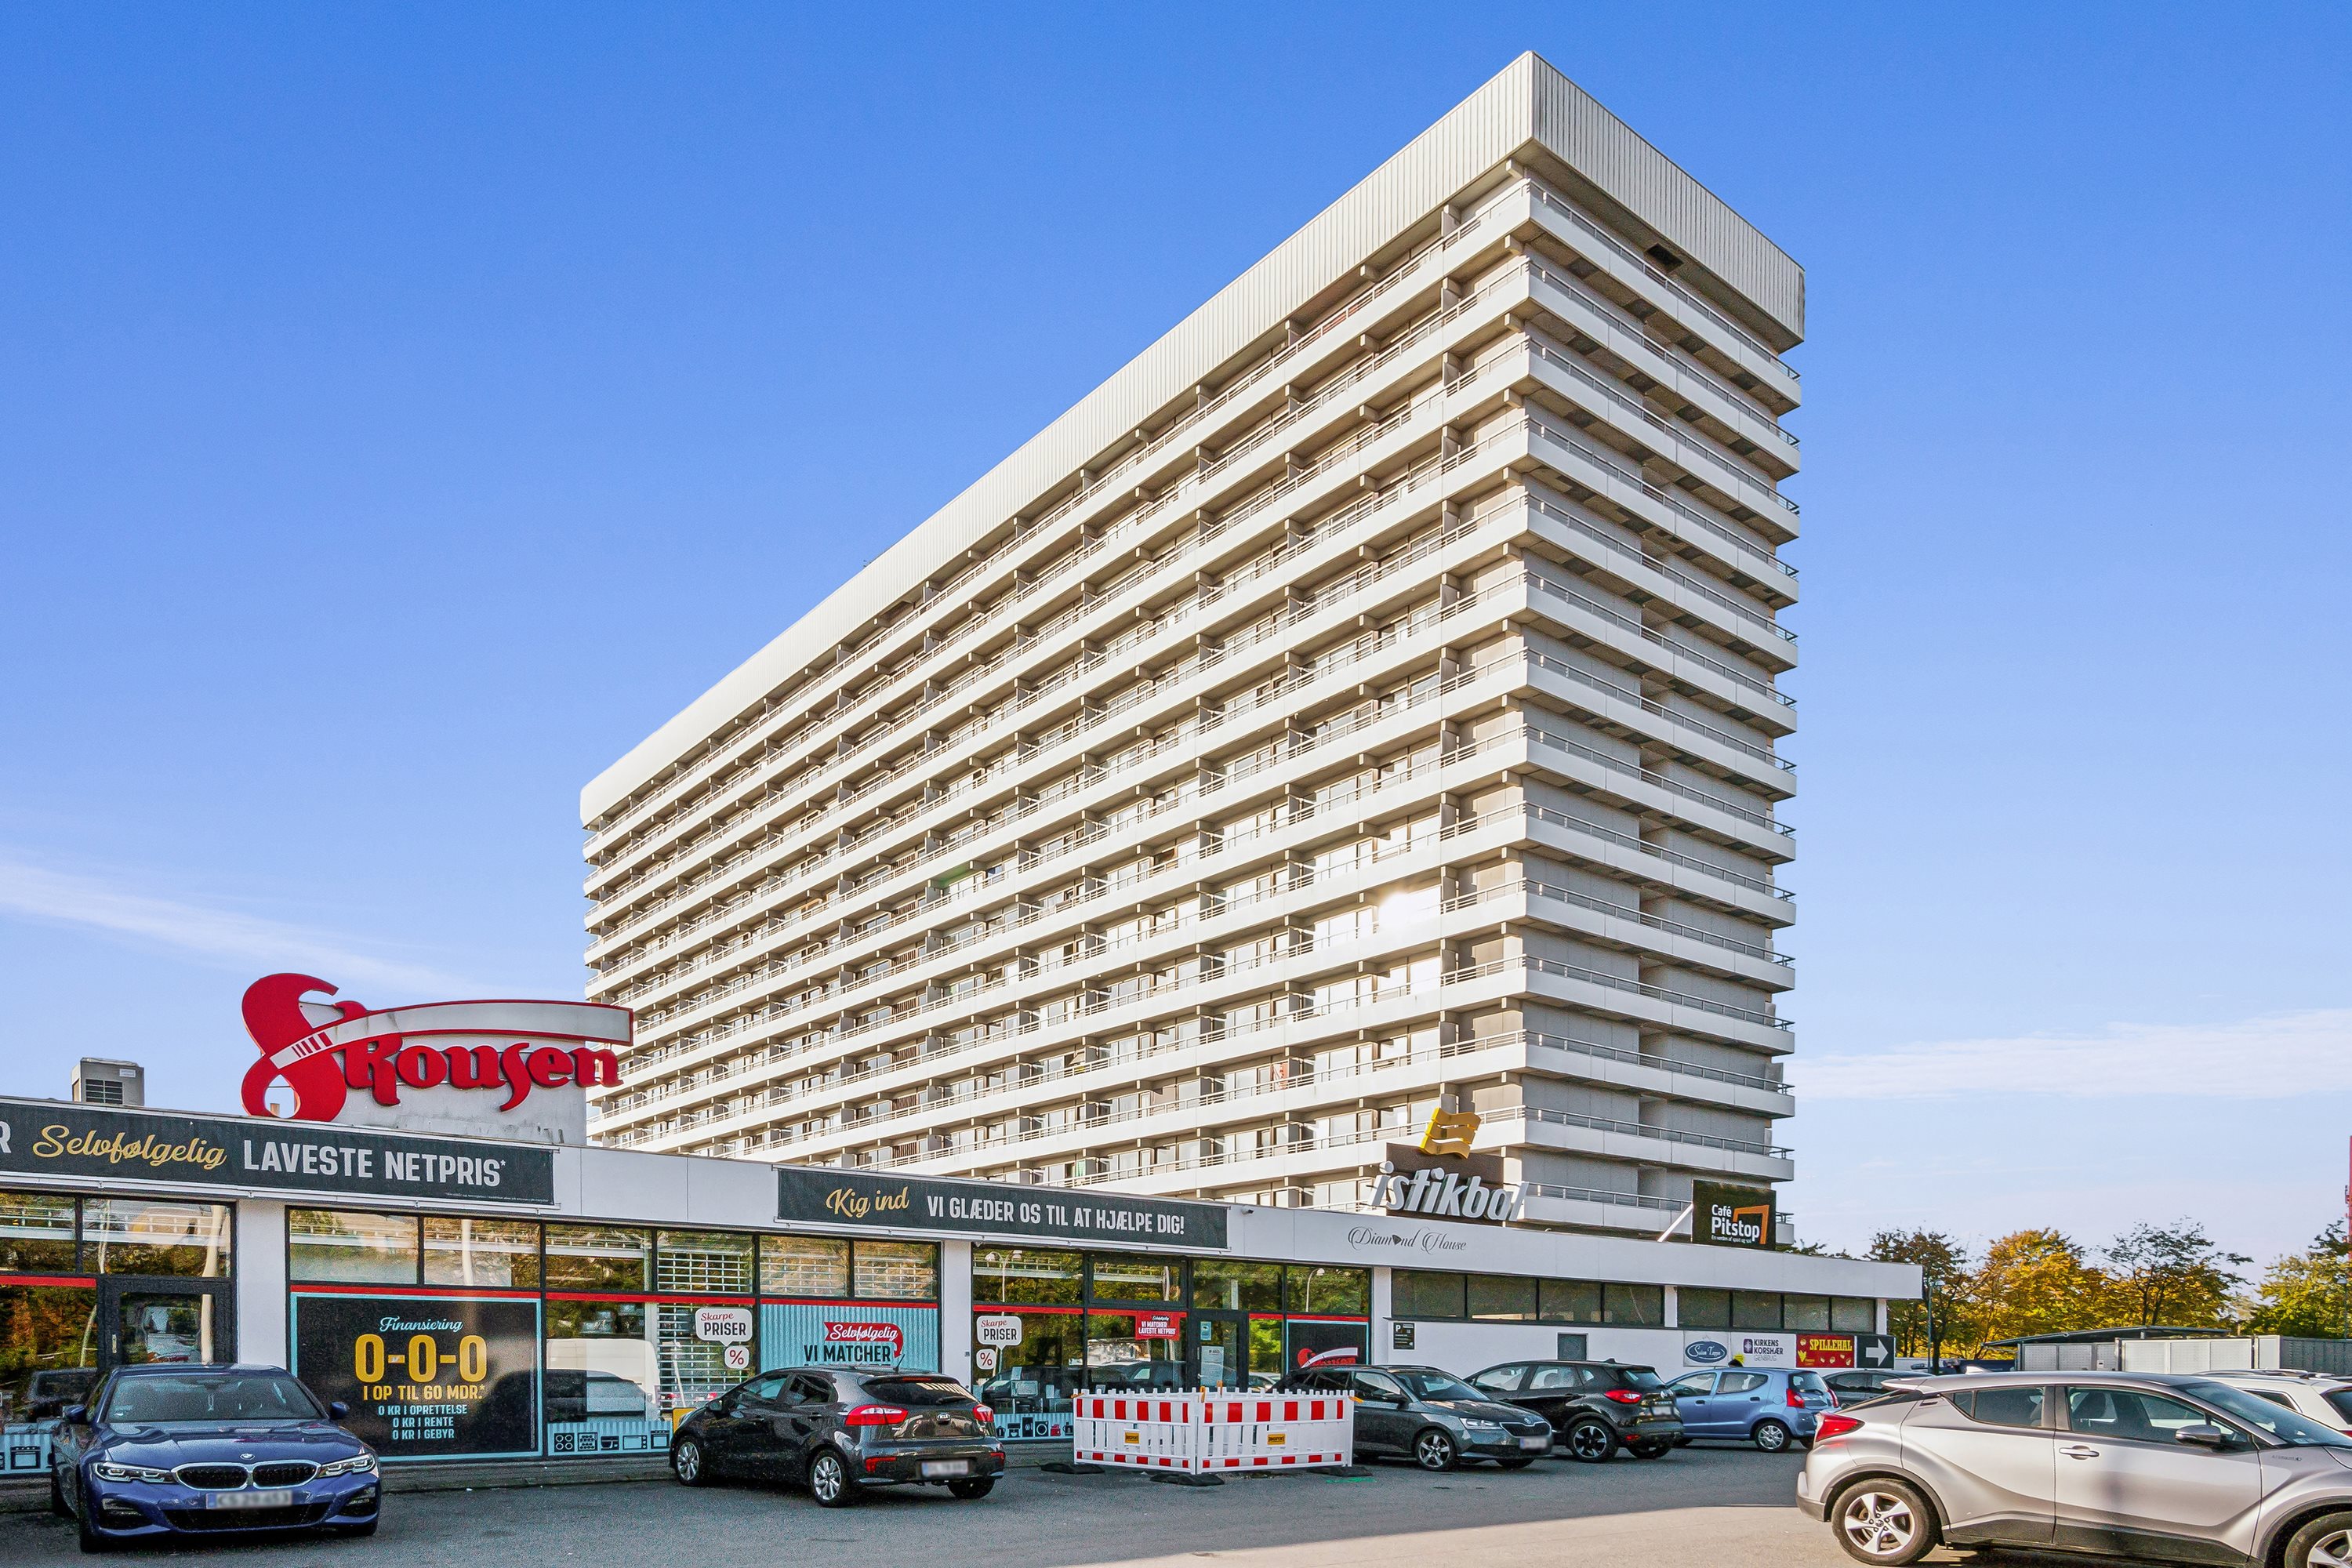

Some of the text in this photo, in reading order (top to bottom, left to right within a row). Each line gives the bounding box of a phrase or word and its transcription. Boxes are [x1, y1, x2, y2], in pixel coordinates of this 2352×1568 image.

[241, 973, 625, 1122] Skousen
[32, 1124, 227, 1171] Selvfølgelig
[244, 1140, 373, 1178] LAVESTE
[1367, 1160, 1529, 1221] istikbal
[826, 1186, 1185, 1235] Kig ind VI GLÆDER OS TIL AT HJÆLPE DIG!
[1711, 1204, 1732, 1217] Café
[1711, 1216, 1760, 1242] Pitstop
[1420, 1226, 1467, 1254] House
[379, 1316, 463, 1333] Finansiering
[701, 1312, 735, 1322] Skarpe
[981, 1319, 1007, 1328] Skarpe
[704, 1322, 746, 1336] PRISER
[829, 1323, 898, 1341] Selvfølgelig
[983, 1328, 1017, 1341] PRISER
[1809, 1338, 1853, 1351] SPILLEHAL
[355, 1334, 488, 1383] 0-0-0
[804, 1345, 891, 1362] VI MATCHER
[372, 1386, 393, 1400] OP
[397, 1385, 419, 1400] TIL
[423, 1385, 443, 1400] 60
[387, 1405, 401, 1415] KR
[410, 1404, 467, 1415] OPRETTELSE
[402, 1417, 416, 1428] KR
[424, 1417, 454, 1427] RENTE
[401, 1429, 415, 1440] KR
[423, 1428, 455, 1439] GEBYR
